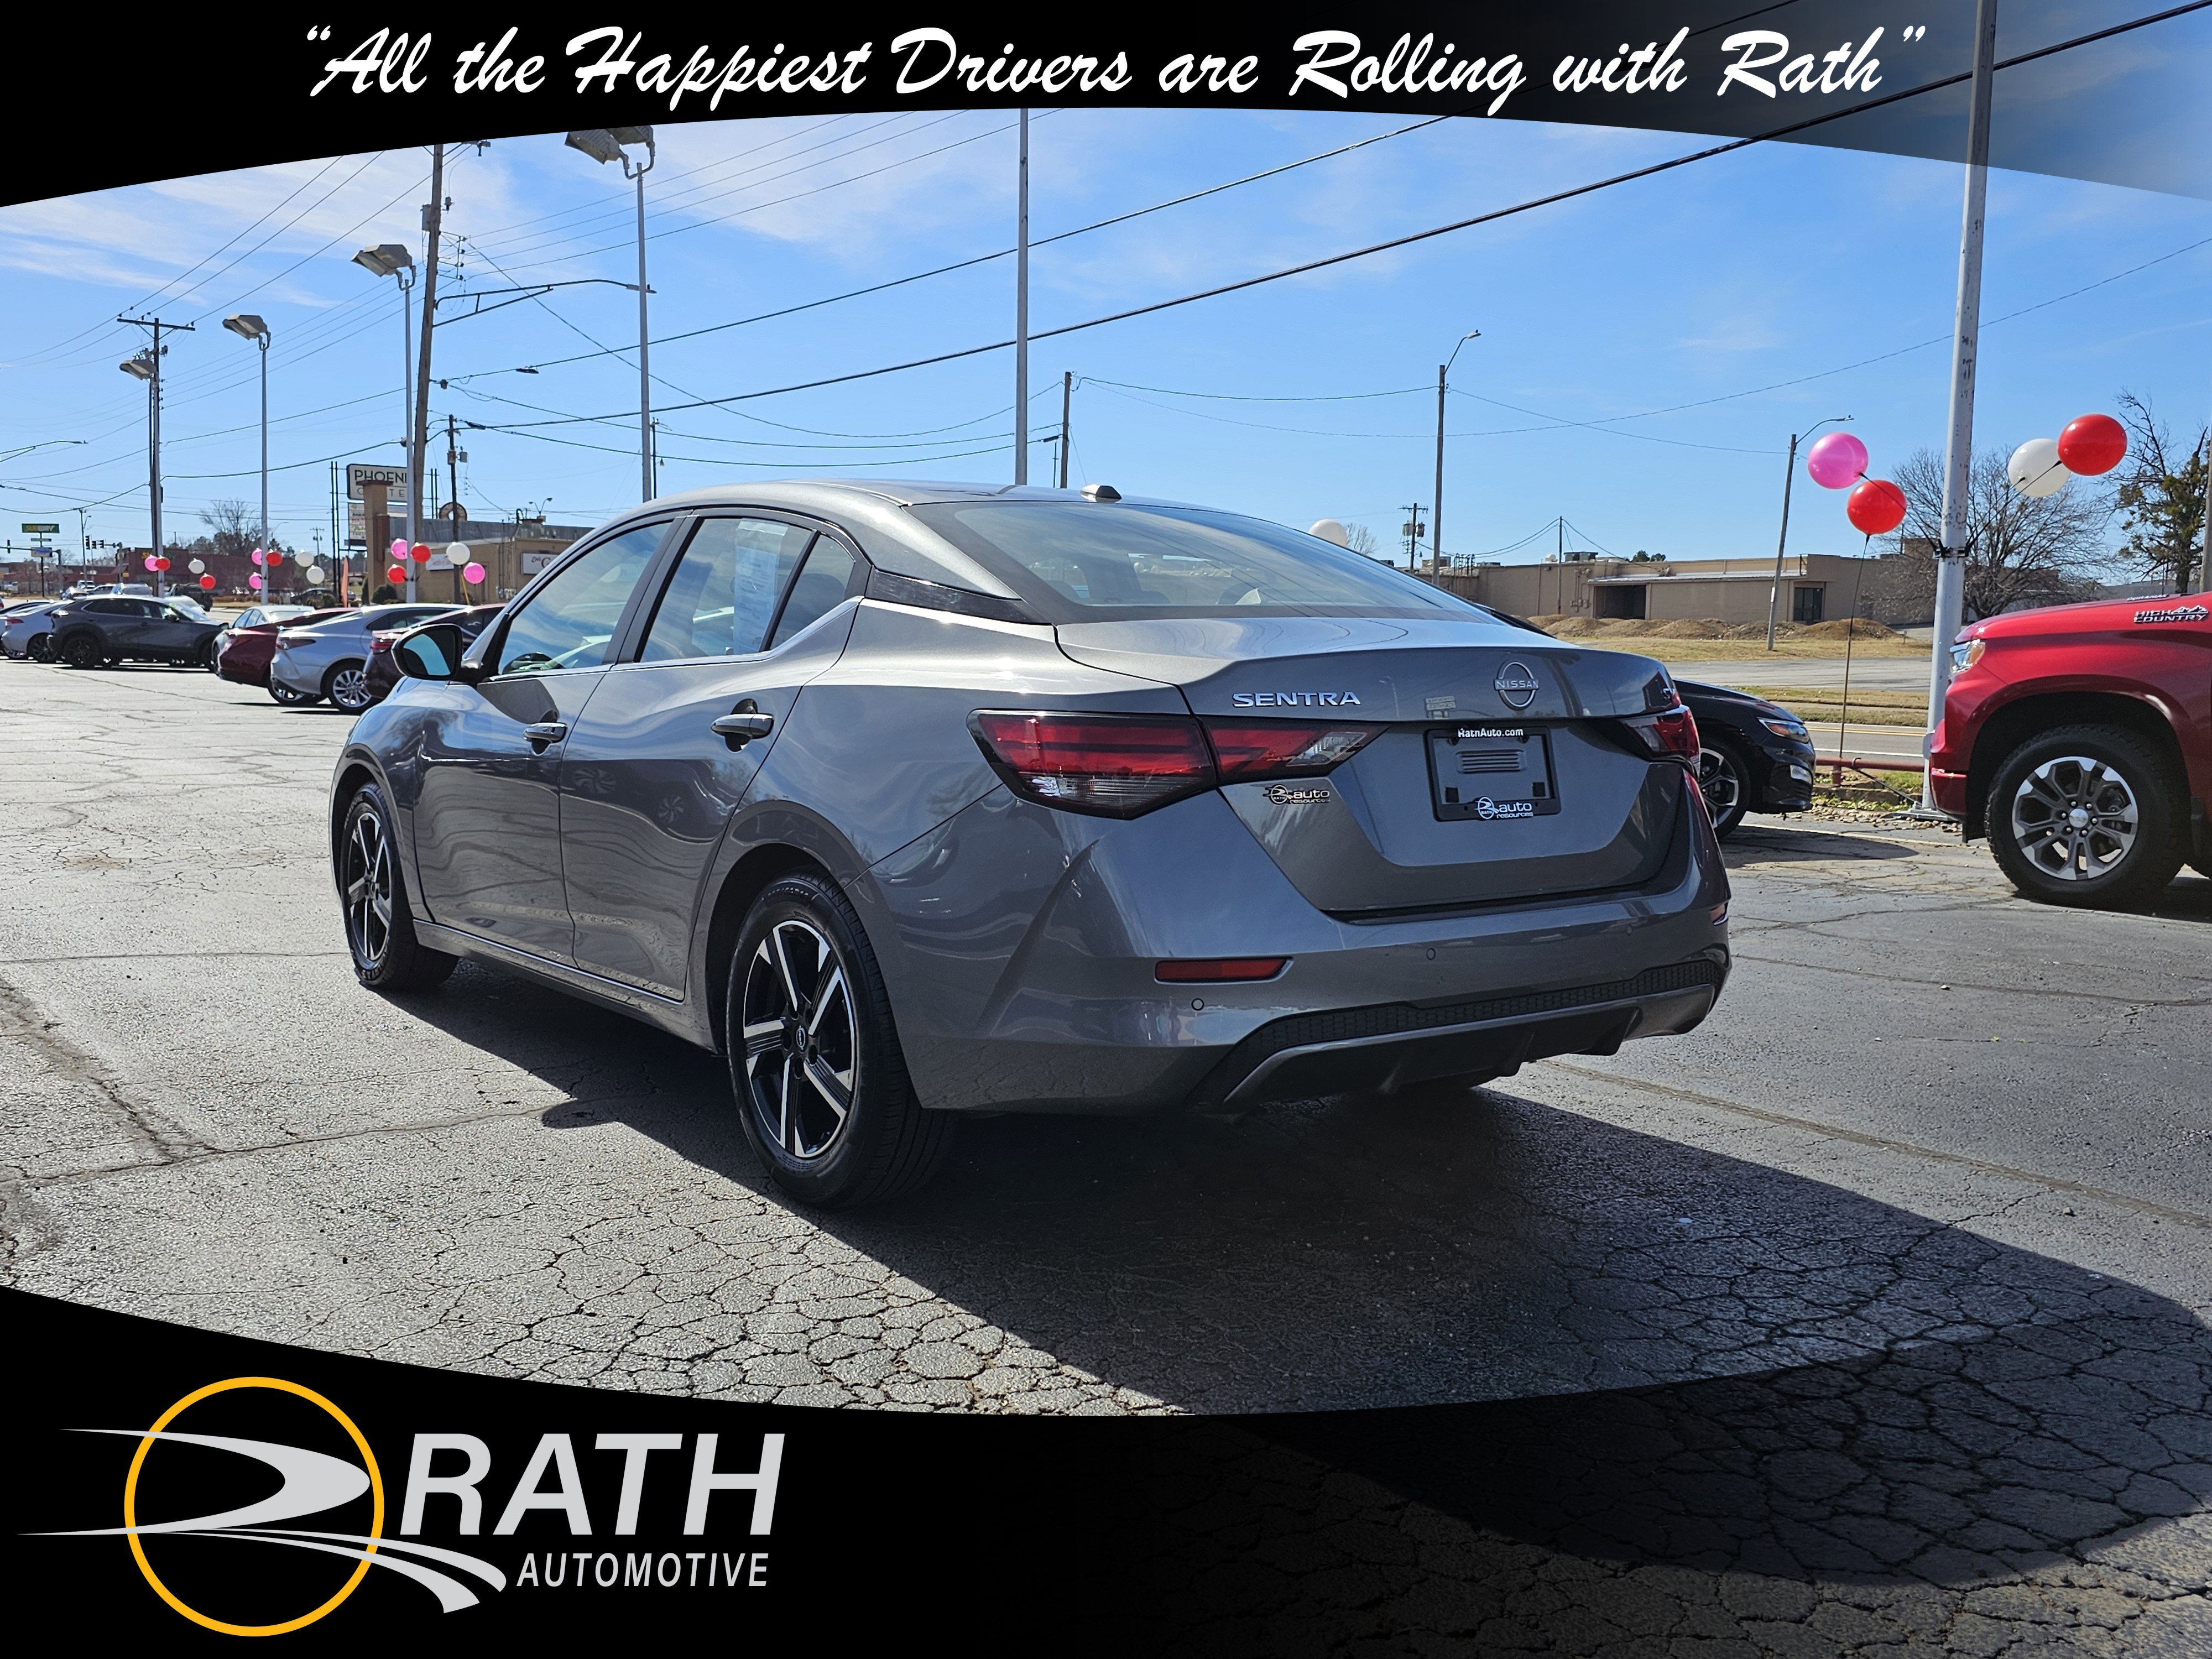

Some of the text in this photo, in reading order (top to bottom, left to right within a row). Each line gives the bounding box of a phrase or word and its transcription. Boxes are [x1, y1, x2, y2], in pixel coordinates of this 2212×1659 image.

[354, 469, 407, 484] PHOENI
[2133, 614, 2206, 623] COUNTRY
[1496, 680, 1539, 688] NISSAN
[1233, 691, 1361, 708] SENTRA
[1293, 789, 1330, 799] auto
[1499, 802, 1532, 813] auto
